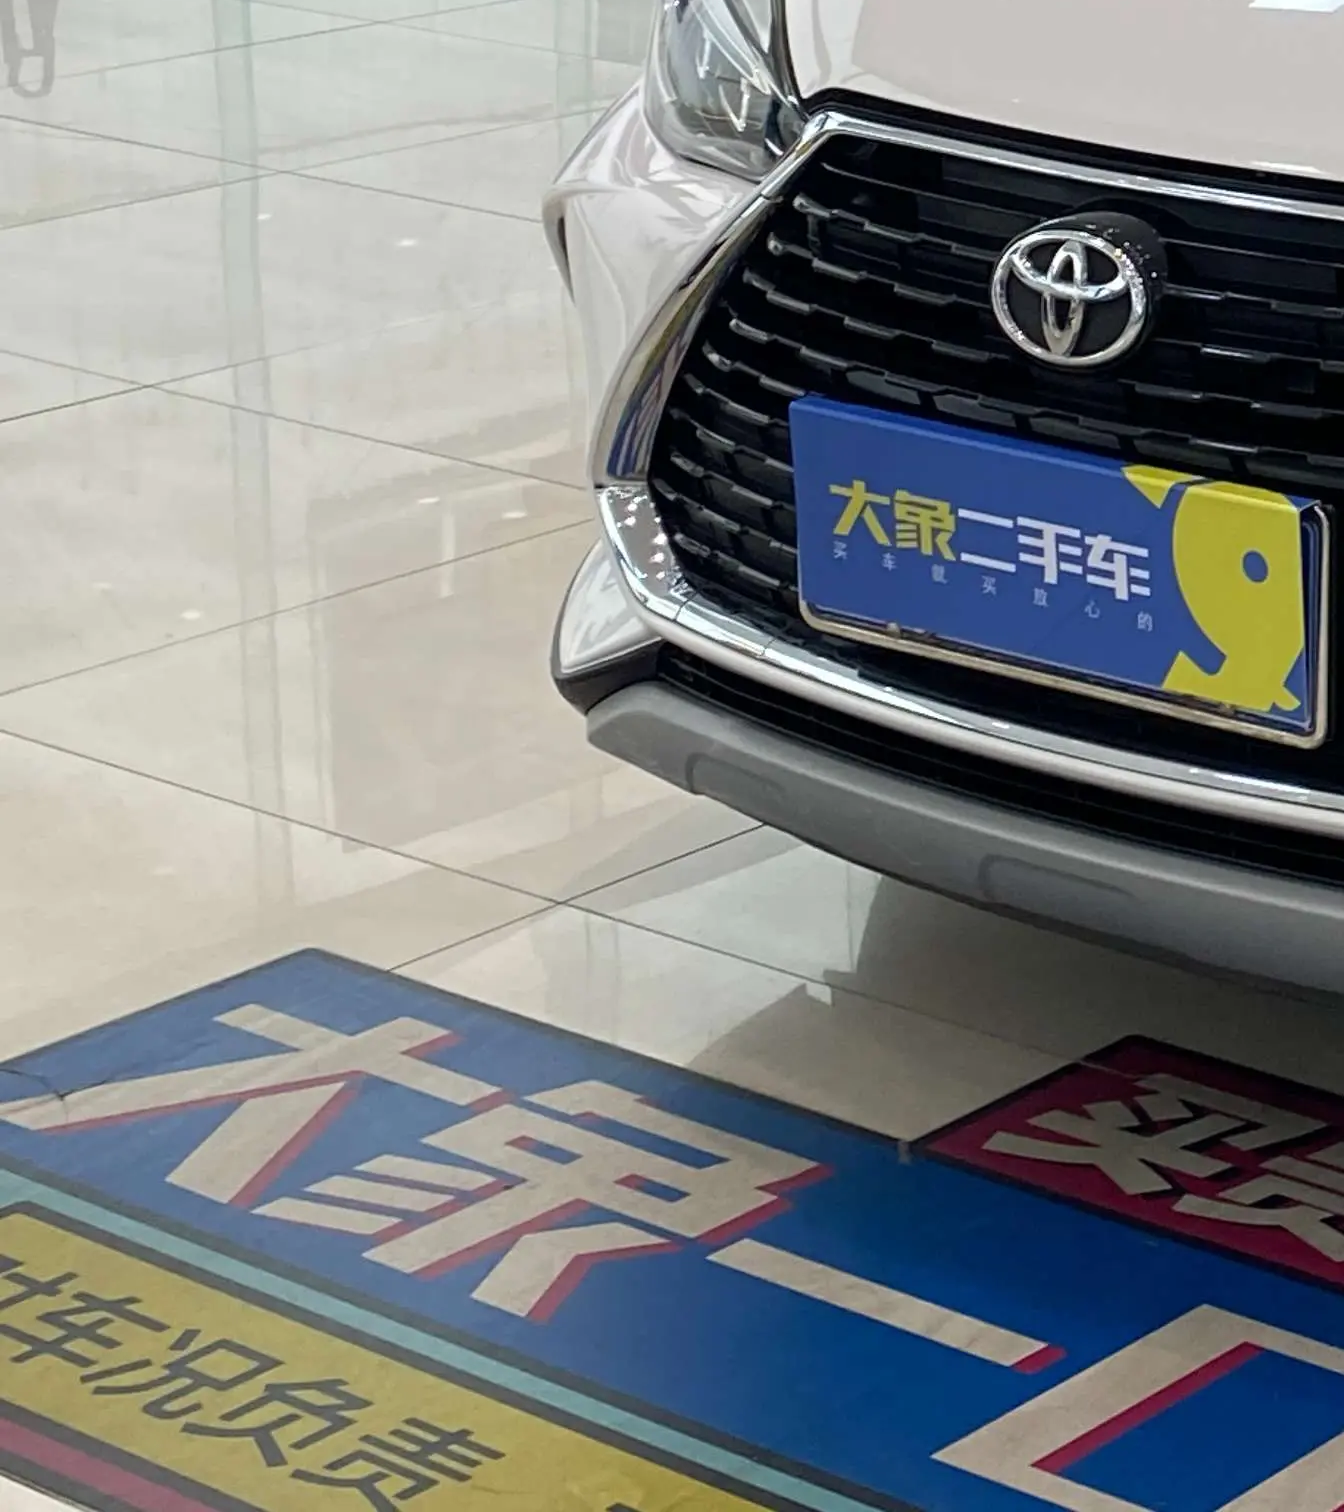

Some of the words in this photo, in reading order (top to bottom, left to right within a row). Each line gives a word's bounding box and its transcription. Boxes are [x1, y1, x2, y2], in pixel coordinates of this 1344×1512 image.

[828, 479, 1151, 601] 大象二手车
